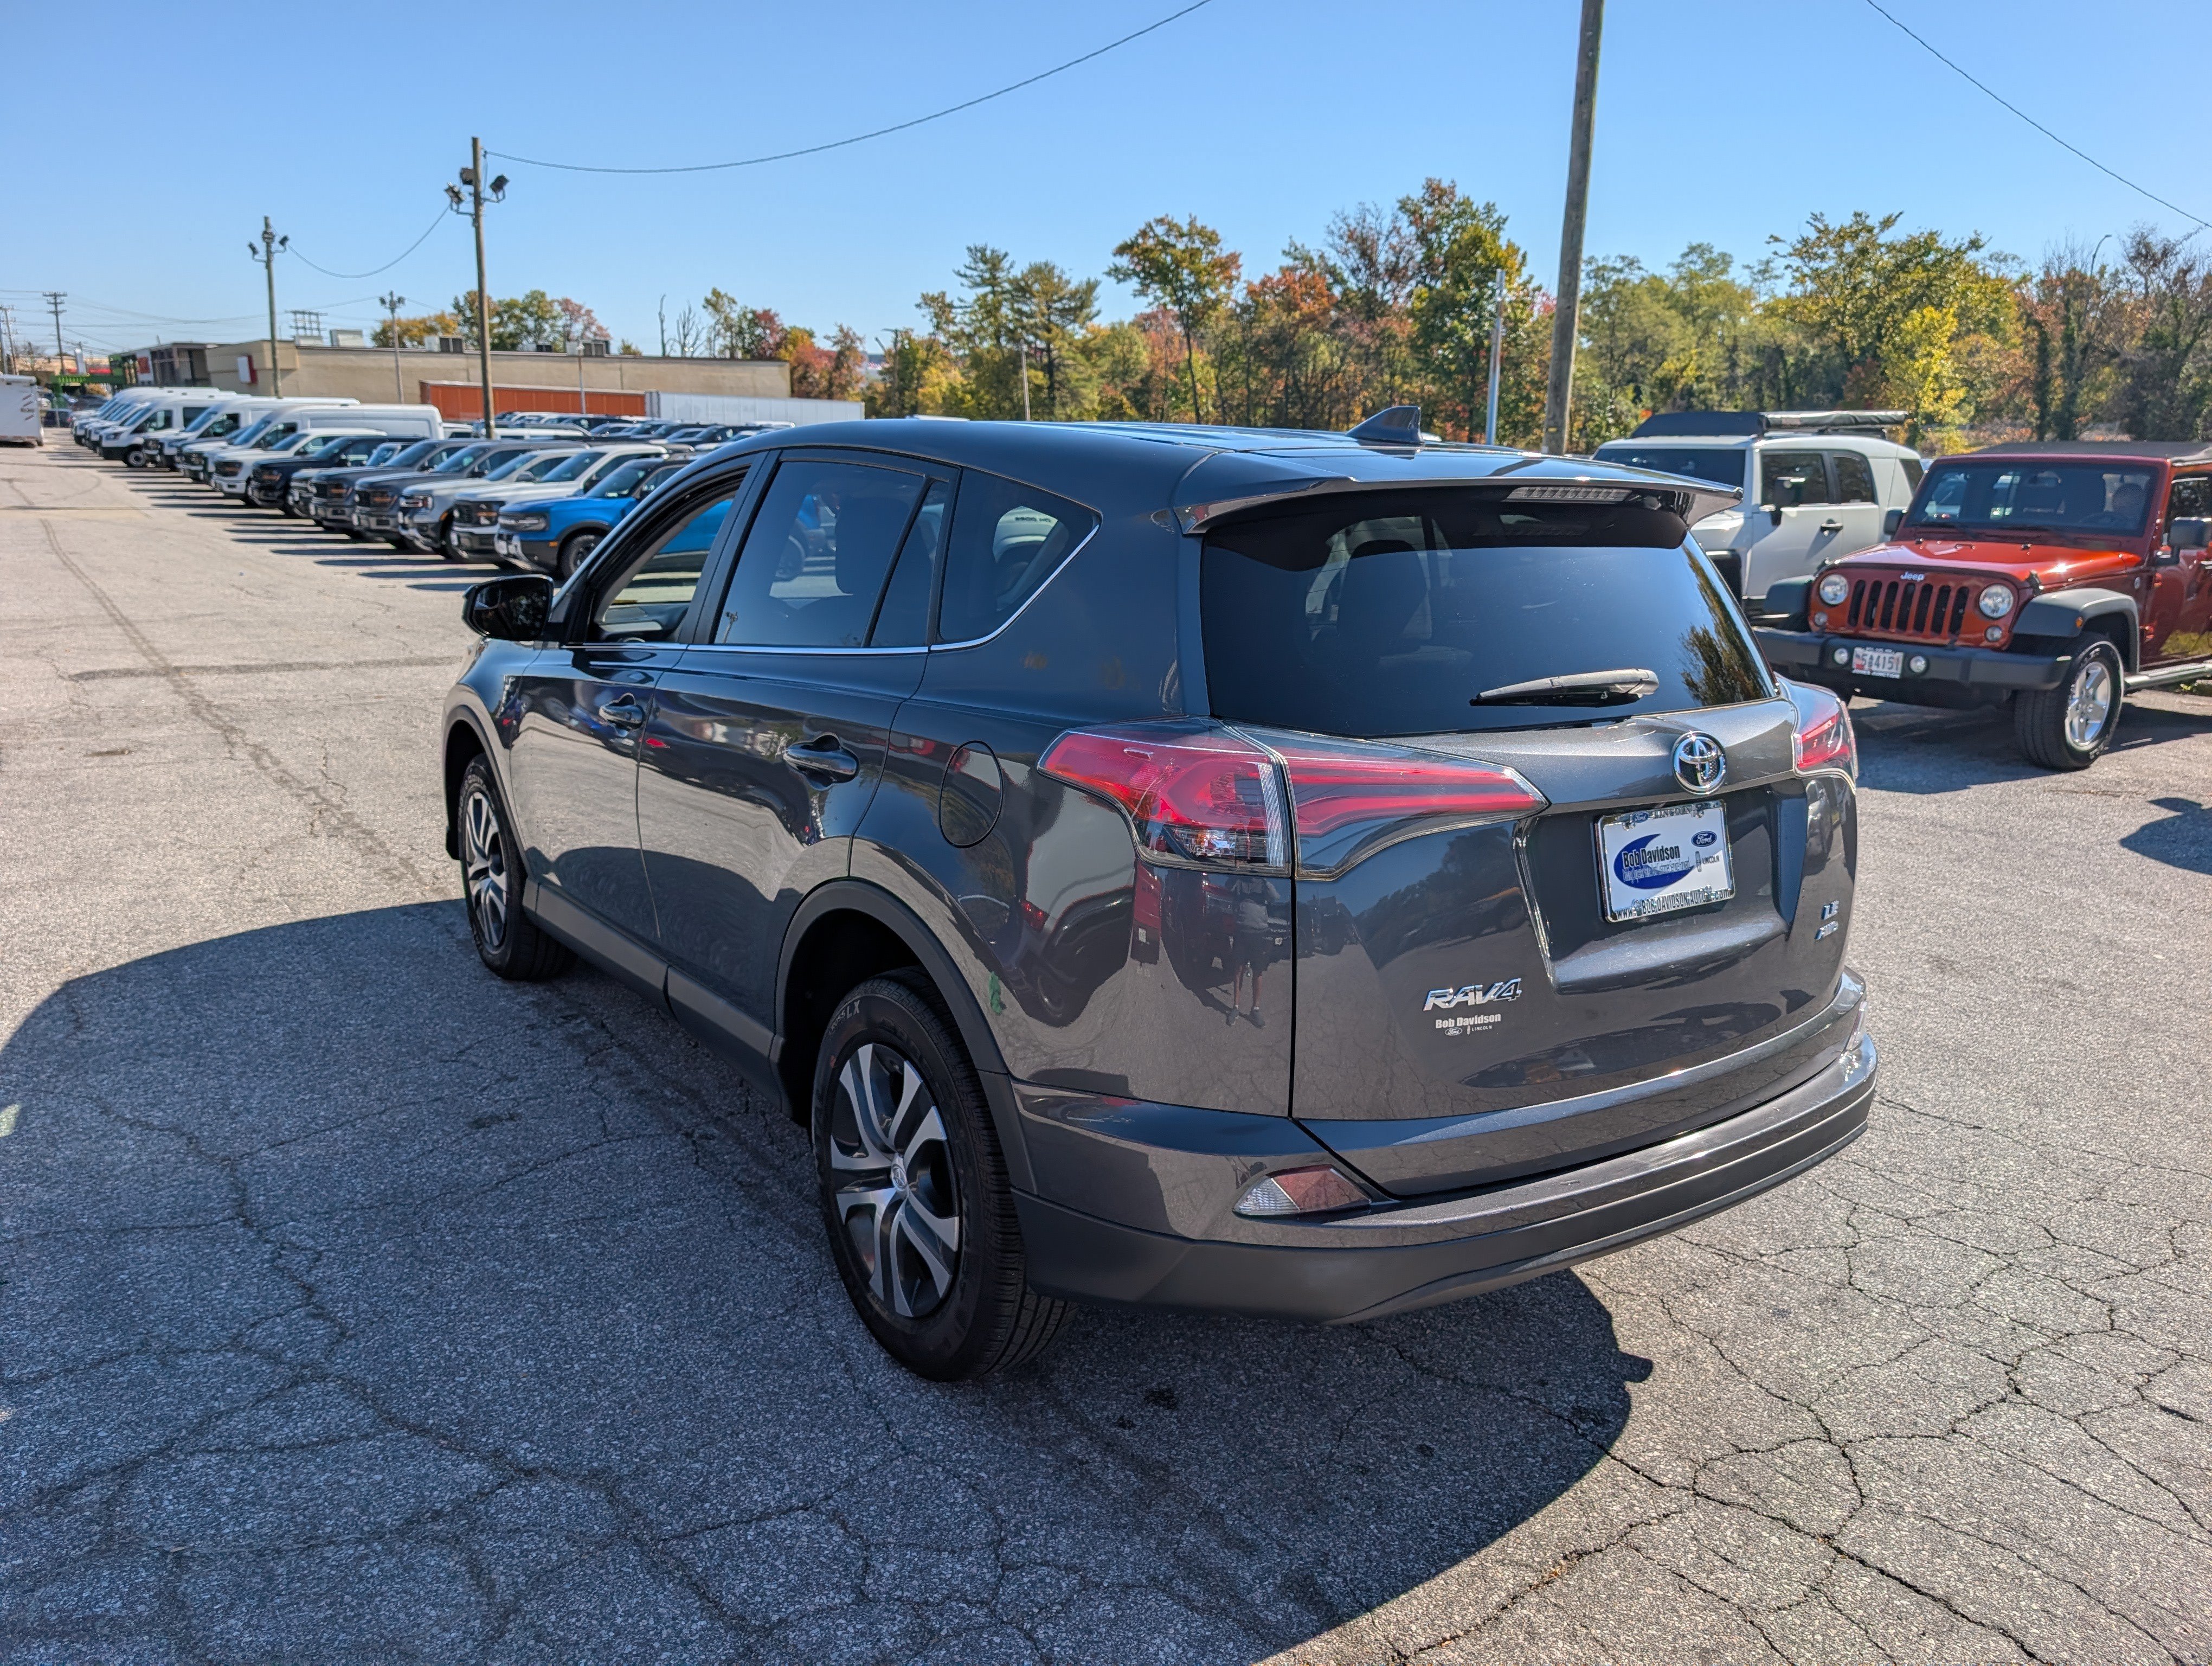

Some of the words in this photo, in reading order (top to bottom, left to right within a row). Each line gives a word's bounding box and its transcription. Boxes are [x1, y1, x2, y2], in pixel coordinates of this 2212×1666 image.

[1900, 572, 1924, 581] Jeep
[1634, 812, 1647, 822] Ford
[1695, 832, 1713, 845] Ford
[1623, 849, 1639, 868] Bob
[1641, 845, 1681, 863] Davidson
[1702, 855, 1720, 864] LINCOLN
[1423, 978, 1522, 1011] RAV4
[847, 999, 860, 1019] LX
[1435, 1018, 1455, 1028] Bob
[1456, 1014, 1501, 1027] Davidson
